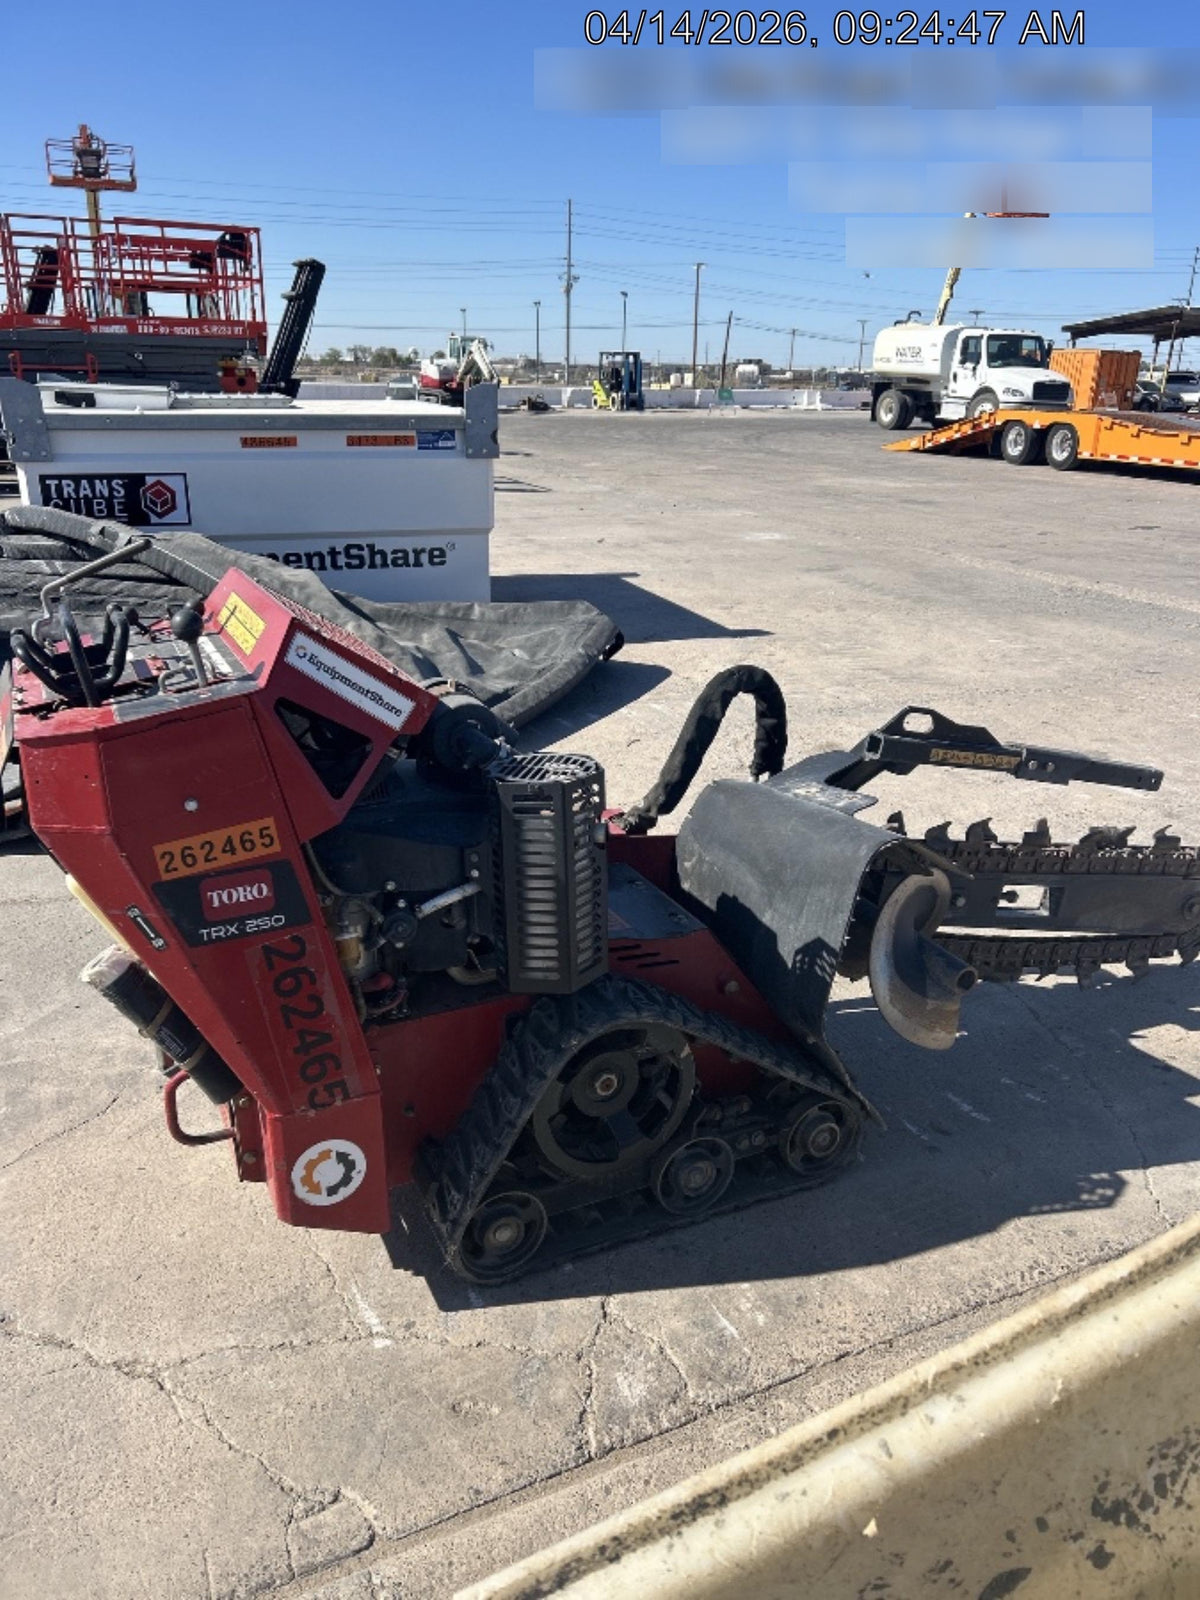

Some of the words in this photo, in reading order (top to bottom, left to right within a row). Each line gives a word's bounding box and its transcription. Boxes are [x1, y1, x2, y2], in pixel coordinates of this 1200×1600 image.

[45, 479, 126, 499] TRANS
[306, 652, 403, 718] EquipmentShare
[159, 826, 275, 873] 262465
[207, 883, 269, 908] TORO
[261, 934, 351, 1111] 262465
